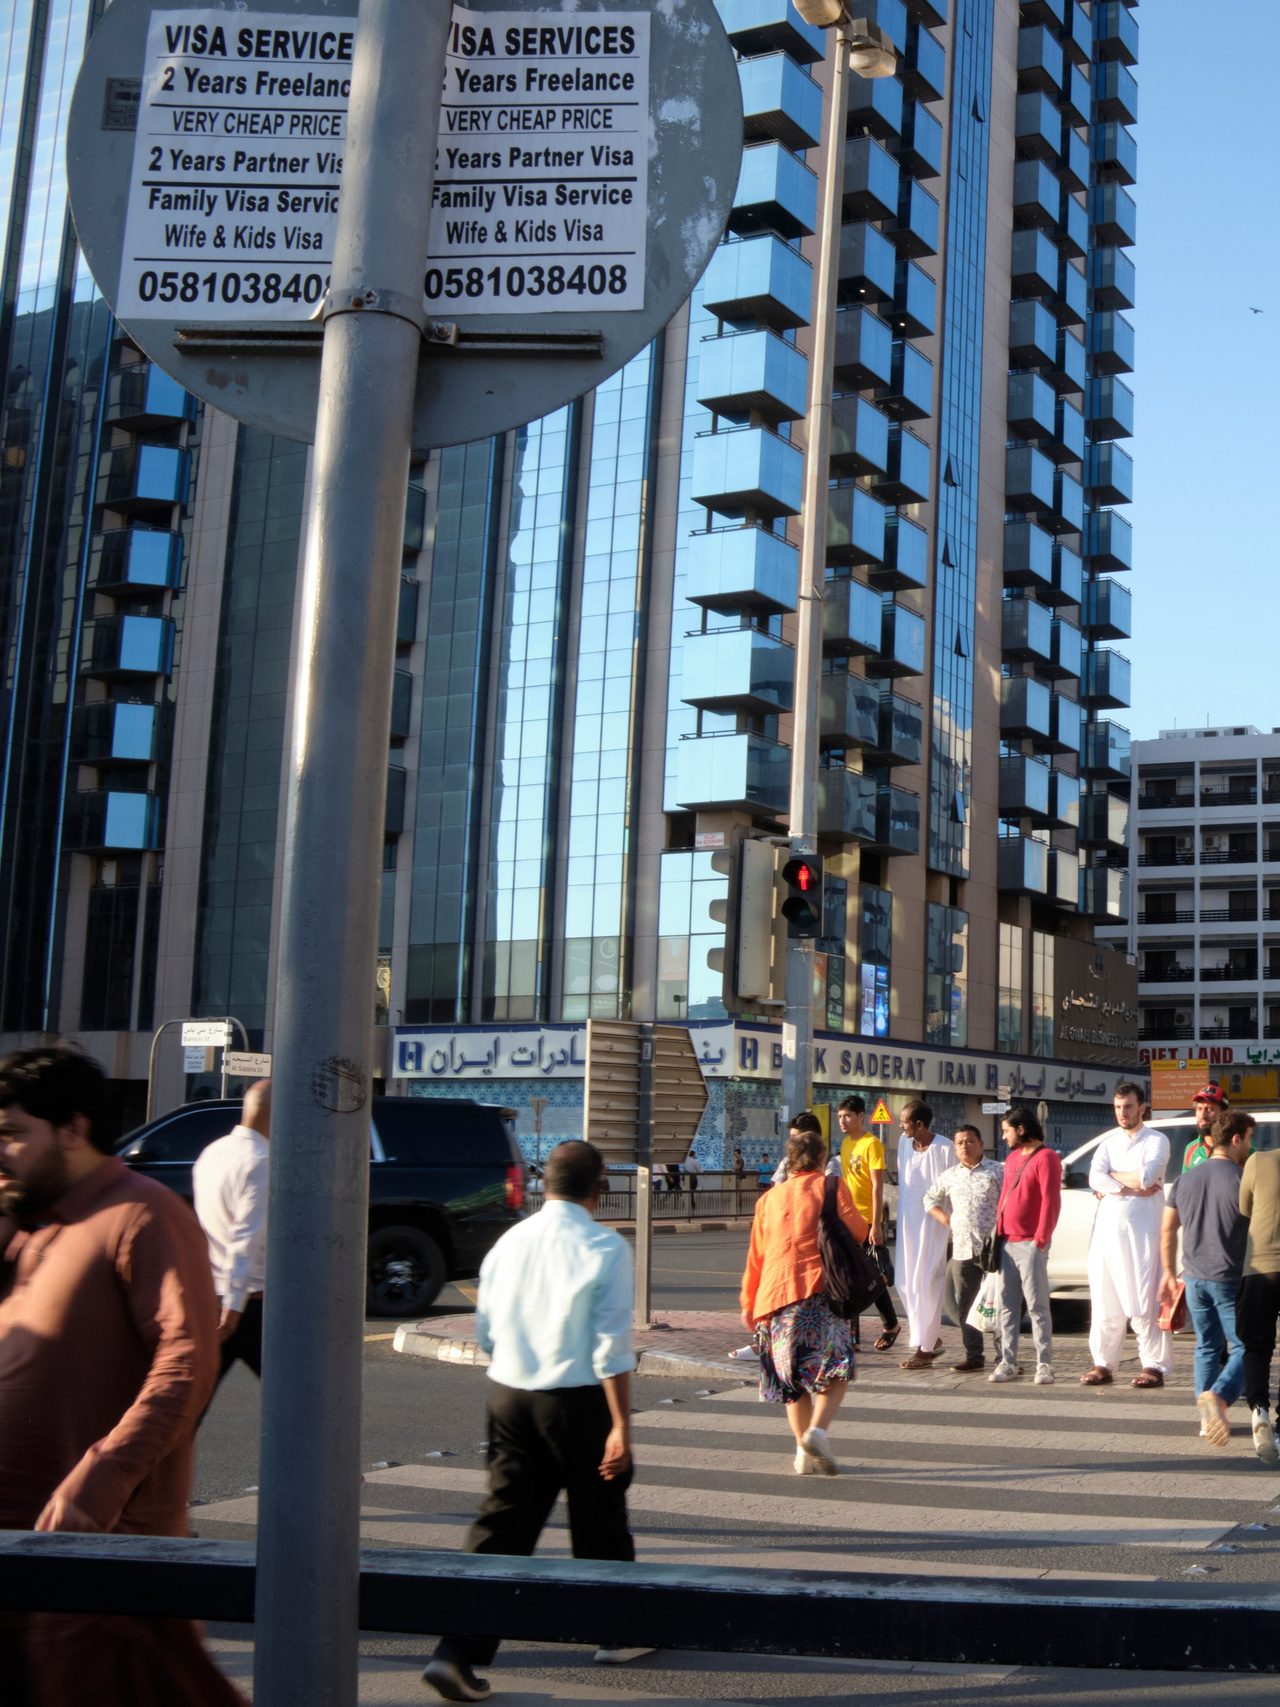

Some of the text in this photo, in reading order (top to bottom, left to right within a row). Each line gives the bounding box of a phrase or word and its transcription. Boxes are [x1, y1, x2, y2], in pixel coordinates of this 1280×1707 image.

[165, 24, 354, 60] VISA SERVICE
[450, 20, 636, 56] ISA SERVICES
[161, 66, 351, 98] 2 Years Freelanc
[454, 67, 517, 93] Years
[525, 67, 635, 92] Freelance
[172, 110, 342, 136] VERY CHEAP PRICE
[446, 108, 613, 131] VERY CHEAP PRICE
[148, 146, 343, 174] 2 Years Partner Vis
[445, 147, 502, 169] Years
[509, 146, 584, 168] Partner
[590, 145, 634, 166] Visa
[148, 187, 339, 217] Family Visa Servic
[431, 183, 633, 213] Family Visa Service
[165, 223, 323, 250] Wife & Kids Visa
[446, 218, 604, 245] Wife & Kids Visa
[138, 270, 331, 304] 058103840
[424, 264, 628, 299] 0581038408
[771, 1042, 827, 1074] BK
[840, 1049, 926, 1084] SADERAT
[938, 1060, 977, 1087] IRAN
